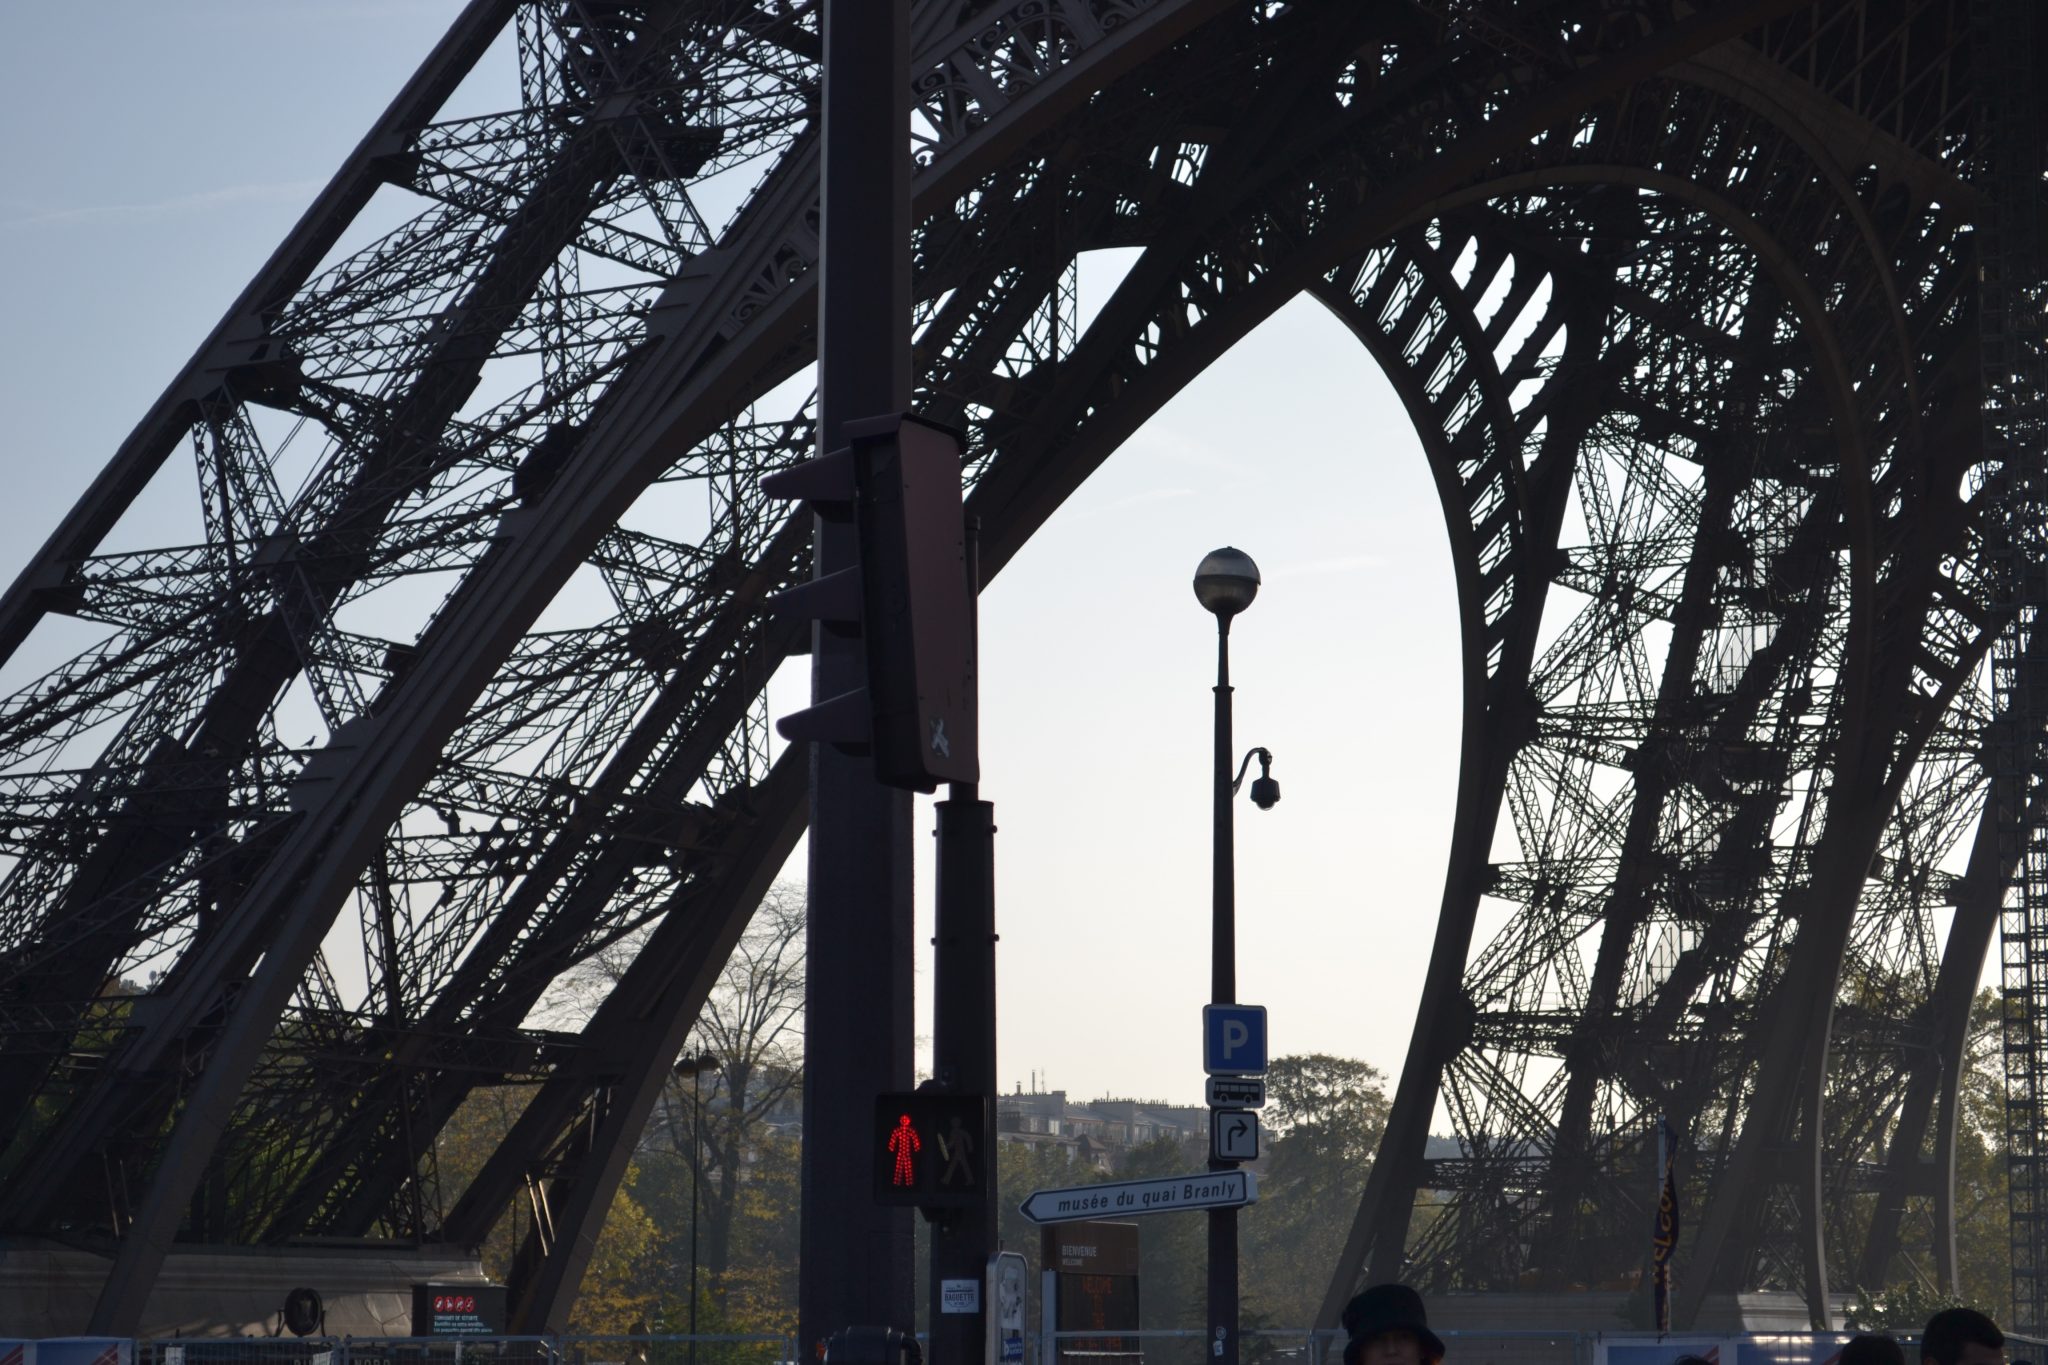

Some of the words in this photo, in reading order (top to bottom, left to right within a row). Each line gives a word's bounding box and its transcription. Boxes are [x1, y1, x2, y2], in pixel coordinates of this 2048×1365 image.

[1223, 1020, 1249, 1060] P
[1058, 1193, 1108, 1212] musée
[1116, 1191, 1134, 1207] du
[1142, 1186, 1176, 1207] quai
[1183, 1181, 1236, 1200] Branly
[1062, 1244, 1097, 1257] BIENVENUE
